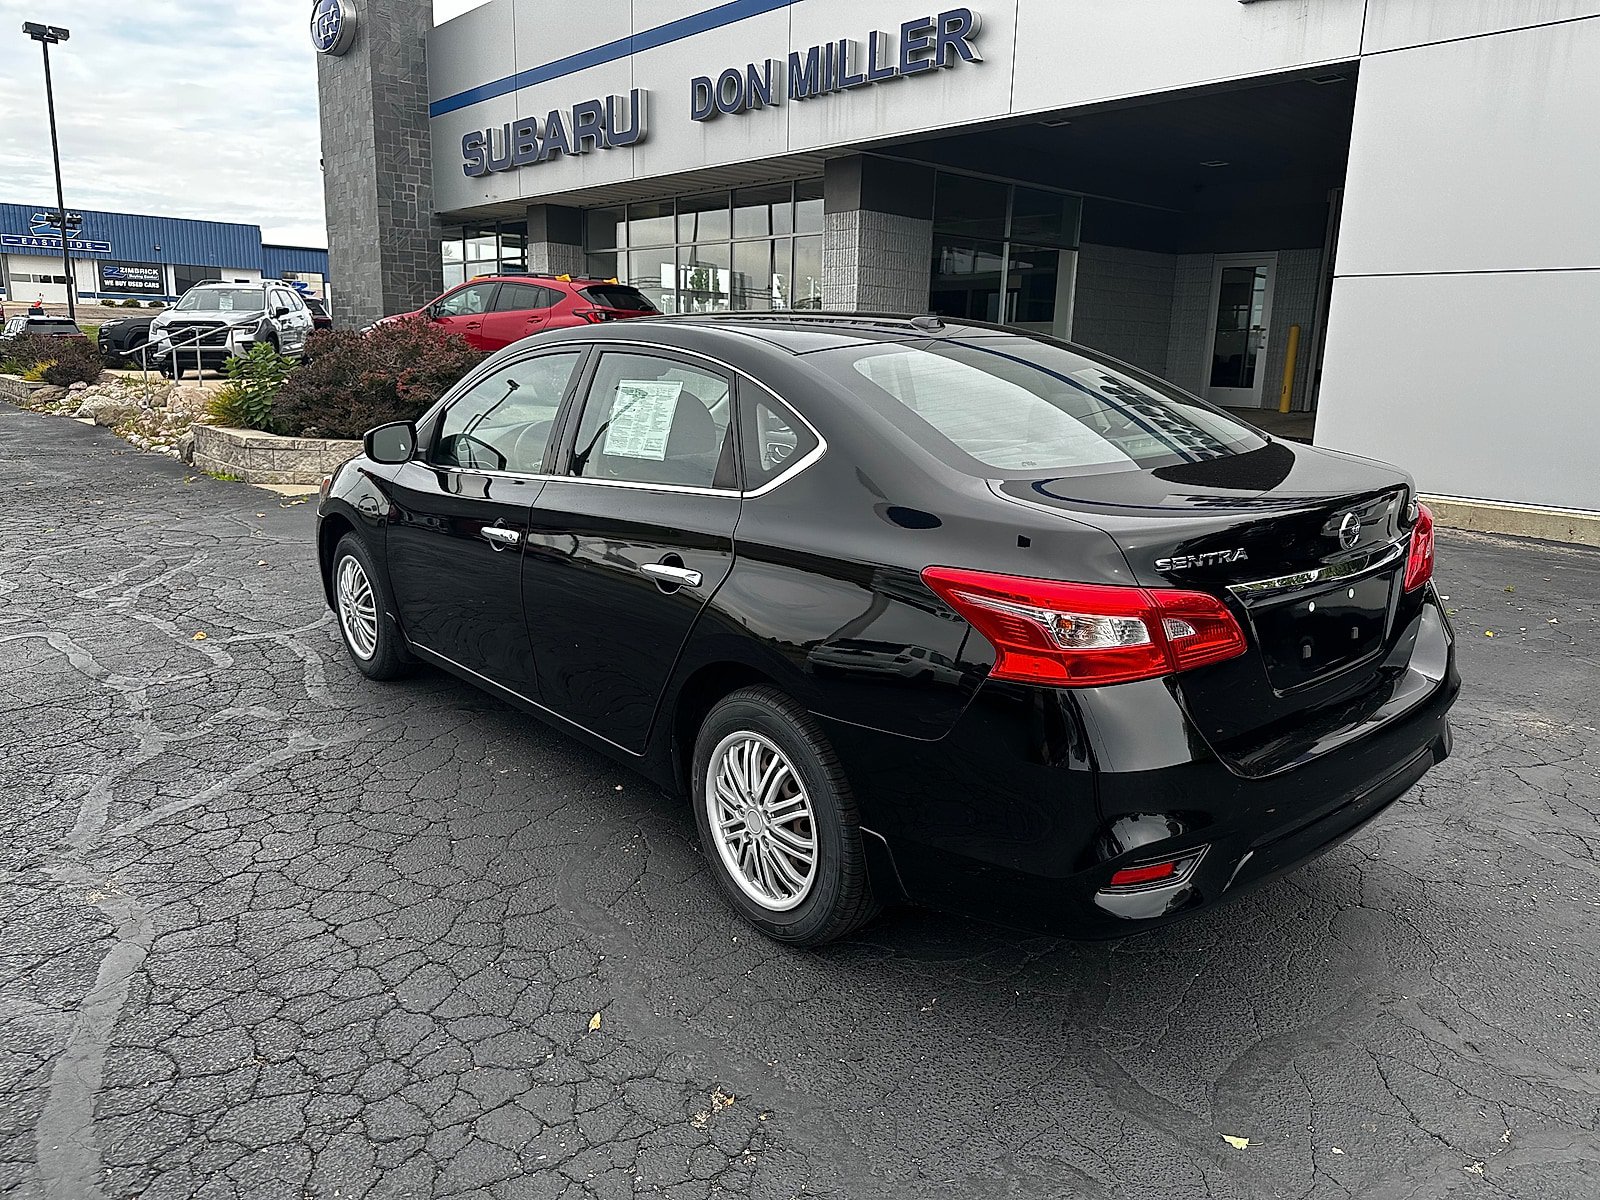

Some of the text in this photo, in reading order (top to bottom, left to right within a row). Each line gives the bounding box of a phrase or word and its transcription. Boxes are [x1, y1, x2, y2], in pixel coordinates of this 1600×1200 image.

[690, 8, 984, 122] DON MILLER
[462, 88, 649, 178] SUBARU
[21, 237, 93, 249] EASTIDE
[114, 280, 127, 288] BUY
[127, 281, 143, 289] USED
[143, 281, 160, 290] CARS
[1154, 547, 1249, 572] SENTRA
